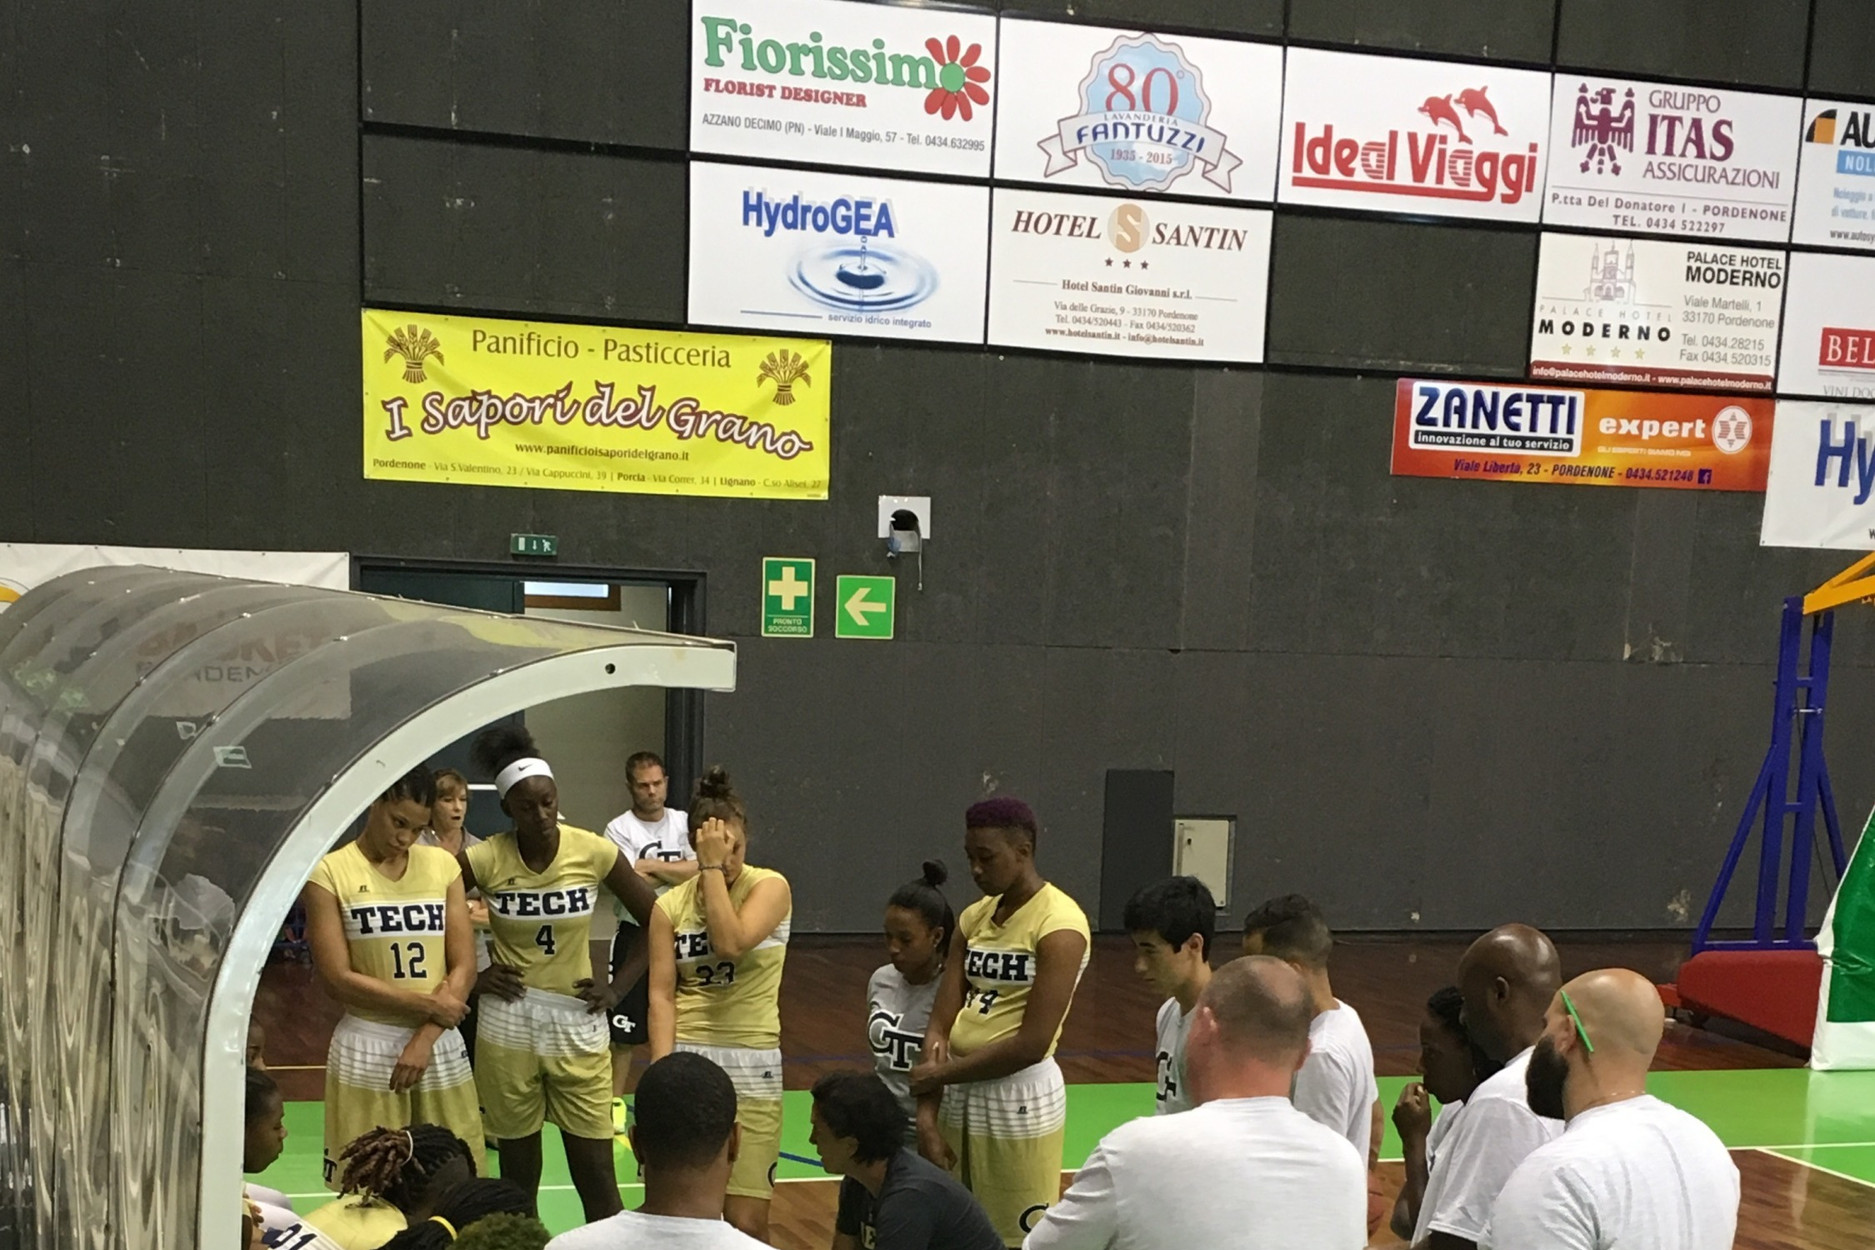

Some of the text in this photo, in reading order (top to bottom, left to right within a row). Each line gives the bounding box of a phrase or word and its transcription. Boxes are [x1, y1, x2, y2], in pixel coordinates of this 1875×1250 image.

[703, 78, 867, 108] FLORIST DESIGNER
[1648, 89, 1721, 113] GRUPPO
[1104, 113, 1179, 126] LAVANDERIA
[701, 113, 741, 128] AZZANO
[744, 117, 782, 132] DECIMO
[784, 121, 805, 136] (PN)
[814, 124, 838, 138] Viale
[846, 128, 883, 144] Maggio,
[885, 131, 897, 143] 57
[906, 133, 922, 146] Tel.
[925, 135, 986, 152] 0434.632995
[1076, 122, 1206, 153] FANTUZZI
[1645, 113, 1735, 162] ITAS
[1110, 149, 1136, 162] 1935
[1146, 152, 1173, 165] 2015
[1292, 121, 1539, 204] Ideal Viaggi
[1845, 154, 1875, 173] NOL
[1642, 160, 1781, 190] ASSICURAZIONI
[742, 189, 896, 239] HydroGEA
[1551, 192, 1582, 206] P.tta
[1614, 197, 1675, 213] Donatore
[1703, 204, 1787, 222] PORDENONE
[1011, 209, 1103, 240] HOTEL
[1151, 222, 1248, 252] SANTIN
[1612, 214, 1726, 233] TEL. 0434 522297
[1687, 250, 1783, 271] PALACE HOTEL
[1685, 265, 1781, 289] MODERNO
[1062, 279, 1193, 300] Hotel Santin Giovanni s.r.l.
[1054, 300, 1198, 321] Via delle Grazie, 9 33170 Pordenone
[1539, 304, 1672, 323] PALACE HOTEL
[1684, 294, 1762, 312] Viale Martelli, 1
[828, 312, 932, 330] servizio idrico integrato
[1055, 314, 1196, 333] Tel. 0434/520443 Fax 0434/520362
[1538, 319, 1671, 342] MODERNO
[1682, 310, 1775, 329] 33170 Pordenone
[472, 329, 580, 360] Panificio
[603, 338, 732, 368] Pasticceria
[1045, 327, 1204, 347] www.hotelsantin.it info@hotelsantin.it
[1681, 333, 1765, 351] Tel. 0434.28215
[1679, 348, 1699, 362] Fax
[1532, 366, 1772, 390] info@palacehotelmoderno.it www.palacehotelmoderno.it
[382, 380, 815, 461] I Sapori del Grano
[1415, 387, 1576, 436] ZANETTI
[1599, 416, 1706, 441] expert
[1417, 432, 1570, 451] innovazione al tuo servizio
[372, 458, 426, 470] Pordenone
[433, 461, 449, 472] Via
[506, 466, 517, 475] 23
[526, 467, 541, 477] Via
[616, 472, 646, 483] Porcia
[652, 473, 666, 483] Via
[720, 477, 756, 488] Lignano
[1454, 458, 1480, 472] Viale
[1527, 462, 1541, 475] 23
[1551, 464, 1616, 479] PORDENONE
[768, 625, 808, 633] SOCCORSO
[773, 617, 803, 626] PRONTO
[495, 888, 590, 917] TECH
[351, 903, 445, 936] TECH
[535, 923, 556, 956] 4
[389, 941, 428, 979] 12
[966, 949, 1029, 982] ECH
